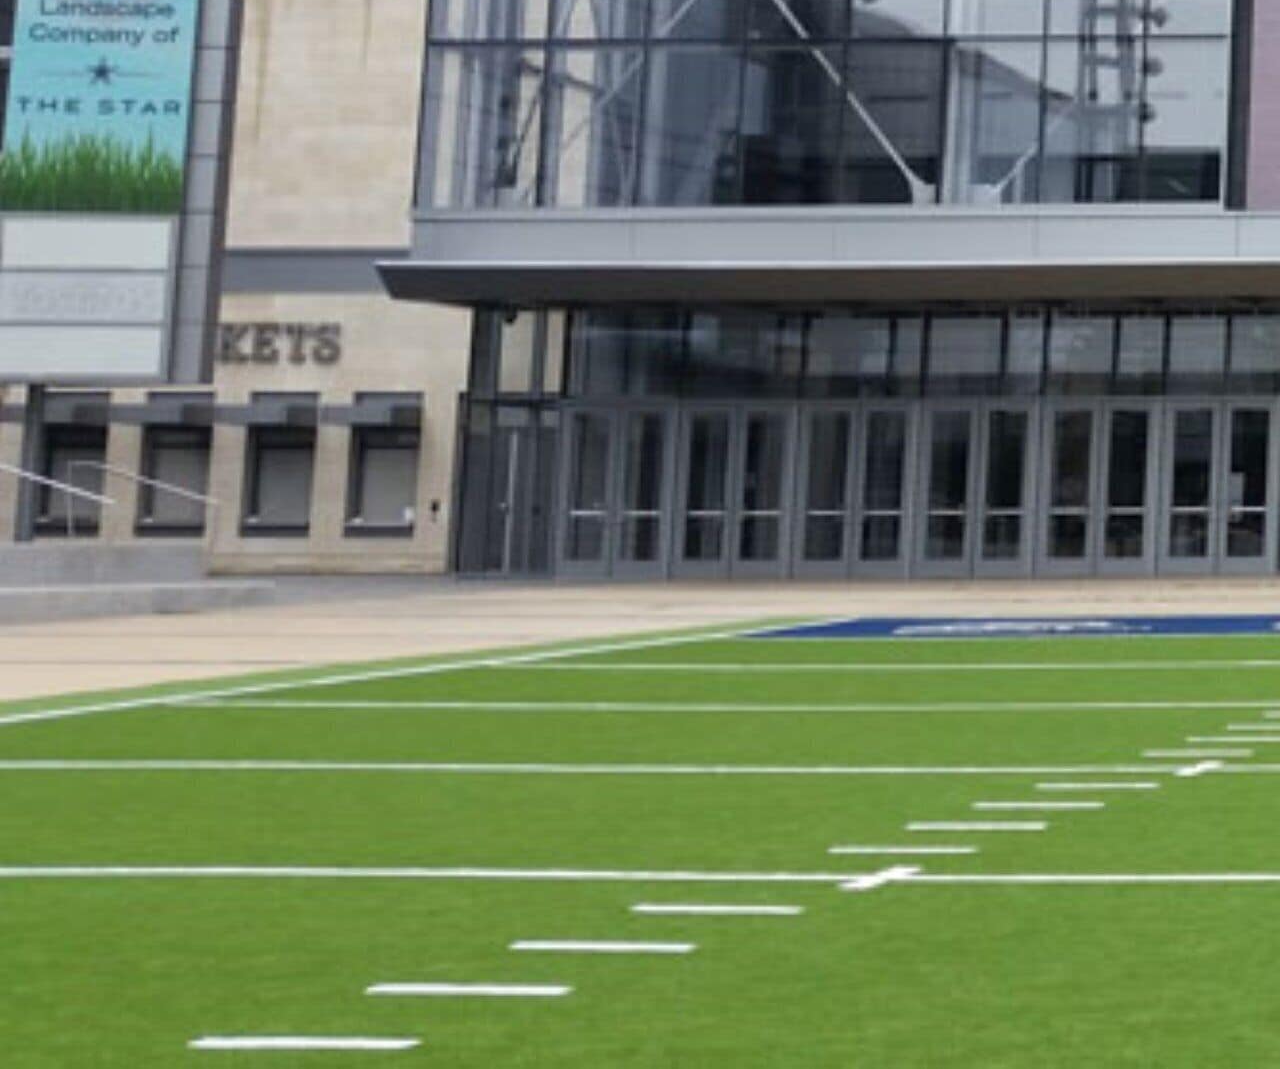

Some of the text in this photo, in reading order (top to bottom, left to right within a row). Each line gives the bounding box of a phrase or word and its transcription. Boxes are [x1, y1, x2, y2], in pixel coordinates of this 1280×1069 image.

[29, 22, 179, 46] Company of
[17, 96, 181, 115] THE STAR
